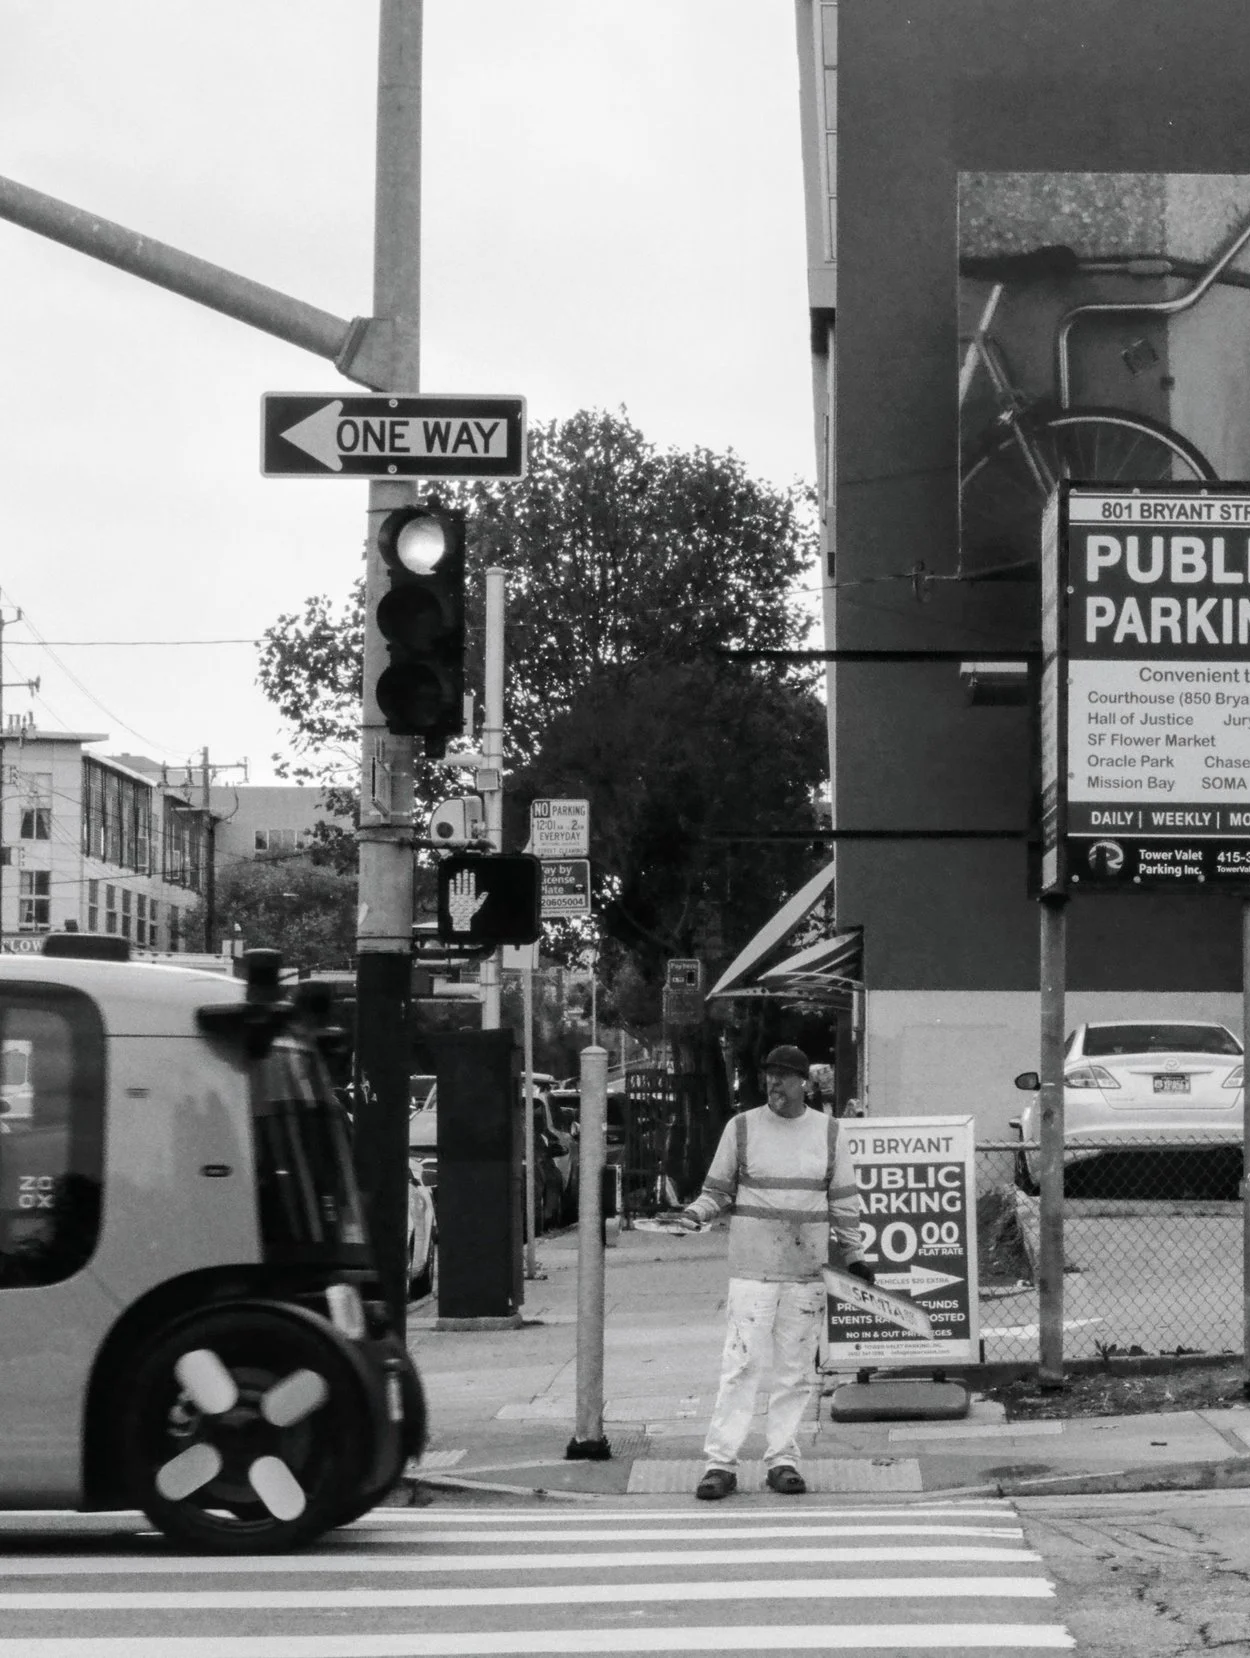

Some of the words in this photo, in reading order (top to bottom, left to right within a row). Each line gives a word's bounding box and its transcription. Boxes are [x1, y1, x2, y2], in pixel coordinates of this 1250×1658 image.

[337, 420, 409, 453] ONE
[424, 422, 500, 455] WAY
[1102, 503, 1132, 520] 801
[1140, 503, 1214, 521] BRYANT
[1139, 667, 1240, 683] Convenient
[1088, 691, 1174, 705] Courthouse
[1179, 691, 1211, 707] (850
[1088, 713, 1116, 726] Hall
[1120, 713, 1134, 726] of
[1140, 713, 1194, 726] Justice
[1088, 734, 1106, 747] SF
[1111, 734, 1161, 747] Flower
[1166, 735, 1216, 748] Market
[1088, 755, 1136, 768] Oracle
[1141, 755, 1174, 769] Park
[1205, 756, 1250, 770] Chase
[1087, 776, 1143, 789] Mission
[1148, 777, 1176, 792] Bay
[1202, 777, 1248, 790] SOMA
[535, 802, 548, 816] NO
[552, 806, 586, 816] PARKING
[1092, 812, 1133, 825] DAILY
[1153, 812, 1211, 826] WEEKLY
[540, 832, 580, 840] EVERYDAY
[1139, 849, 1171, 861] Tower
[1175, 850, 1202, 861] Valet
[542, 867, 556, 876] ay
[560, 865, 572, 876] by
[1139, 864, 1180, 877] Parking
[1184, 864, 1202, 876] Inc.
[542, 876, 575, 884] icense
[849, 1139, 865, 1155] 01
[873, 1138, 953, 1154] BRYANT
[19, 1175, 54, 1190] ZO
[856, 1166, 961, 1190] UBLIC
[859, 1191, 962, 1214] ARKING
[831, 1221, 917, 1263] 20
[921, 1221, 959, 1244] 00
[915, 1300, 959, 1309] FUNDS
[831, 1315, 873, 1325] EVENTS
[929, 1313, 966, 1322] OSTED
